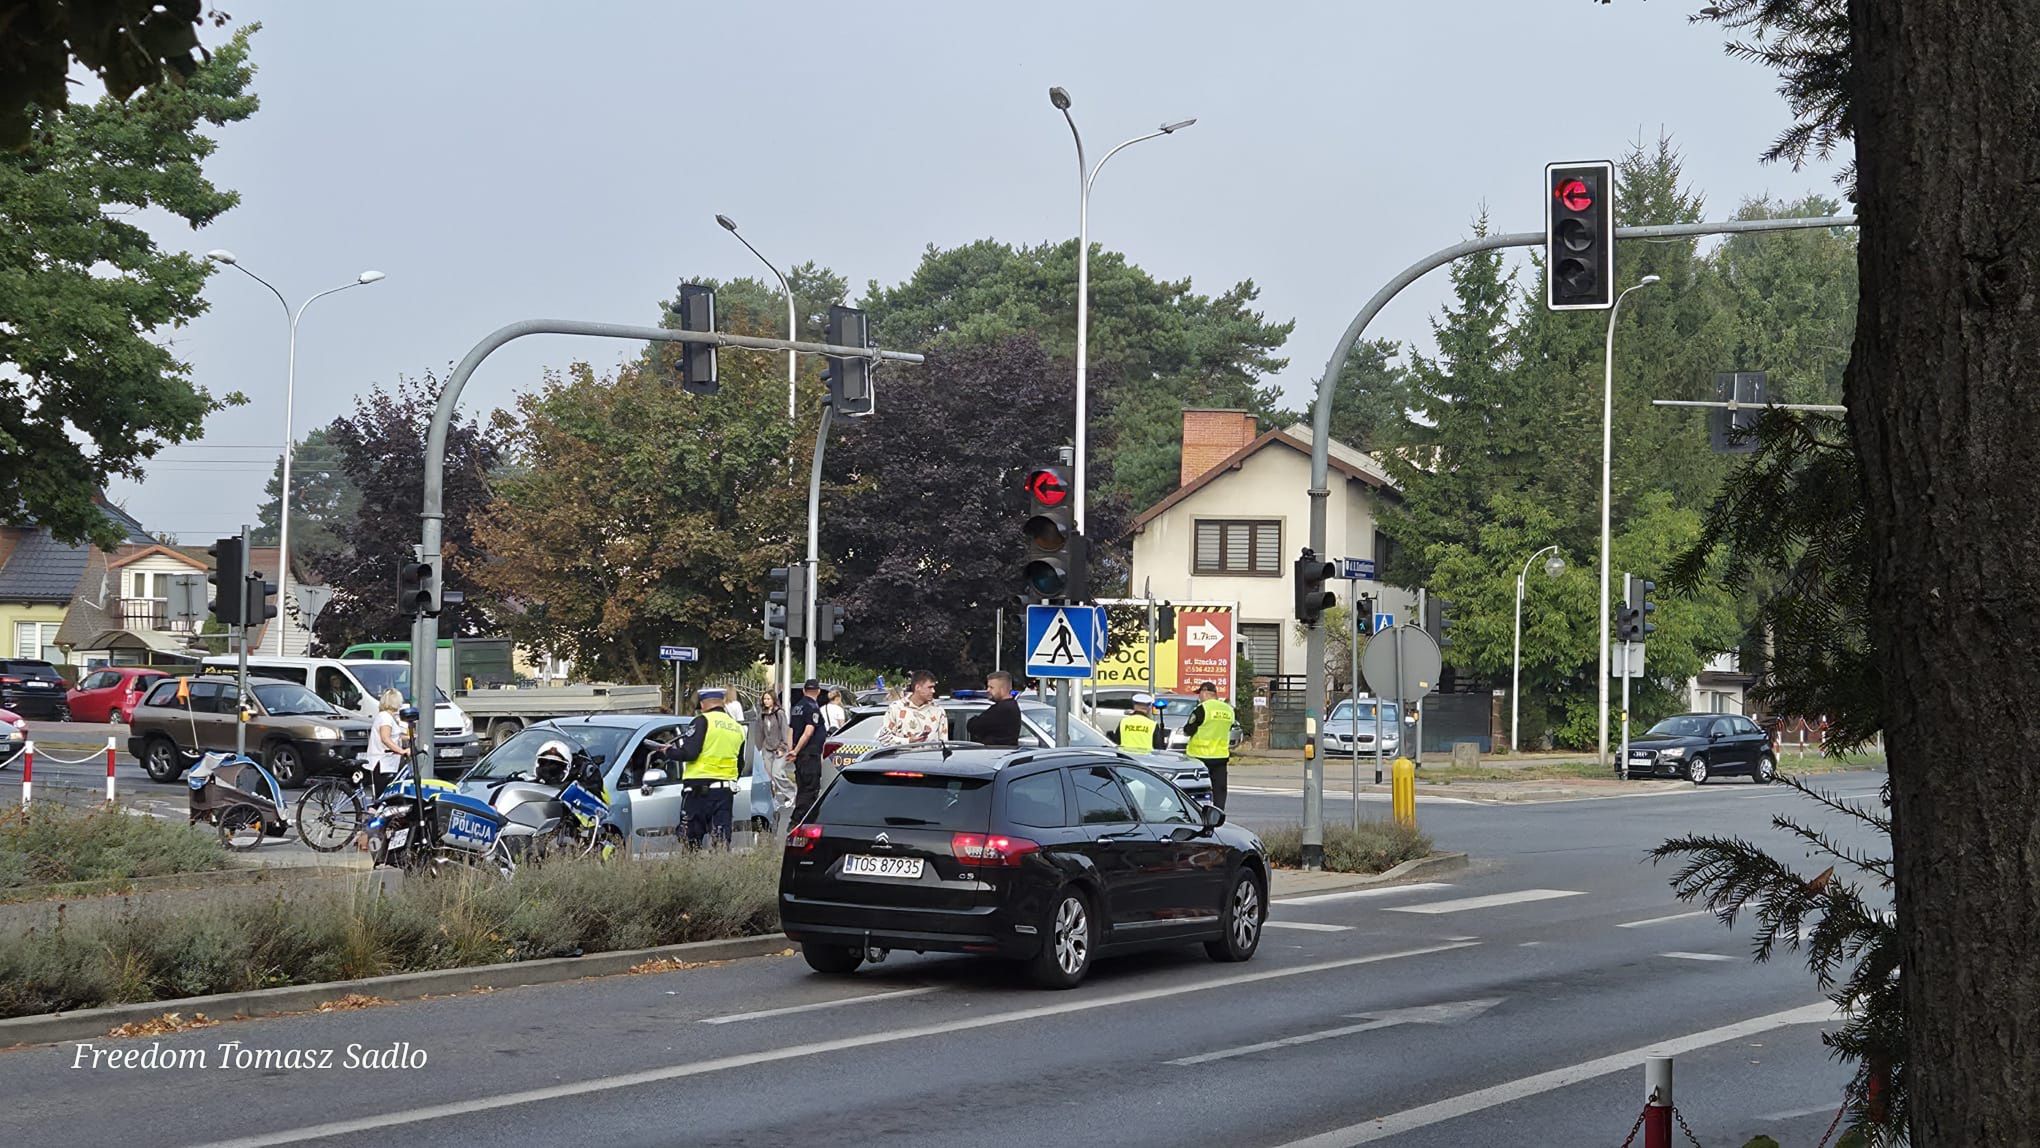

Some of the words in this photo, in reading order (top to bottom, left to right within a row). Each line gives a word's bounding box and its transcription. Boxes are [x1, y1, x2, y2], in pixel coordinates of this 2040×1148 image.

[451, 816, 491, 840] POLICJA
[854, 857, 877, 872] TOS
[880, 858, 920, 874] 87935
